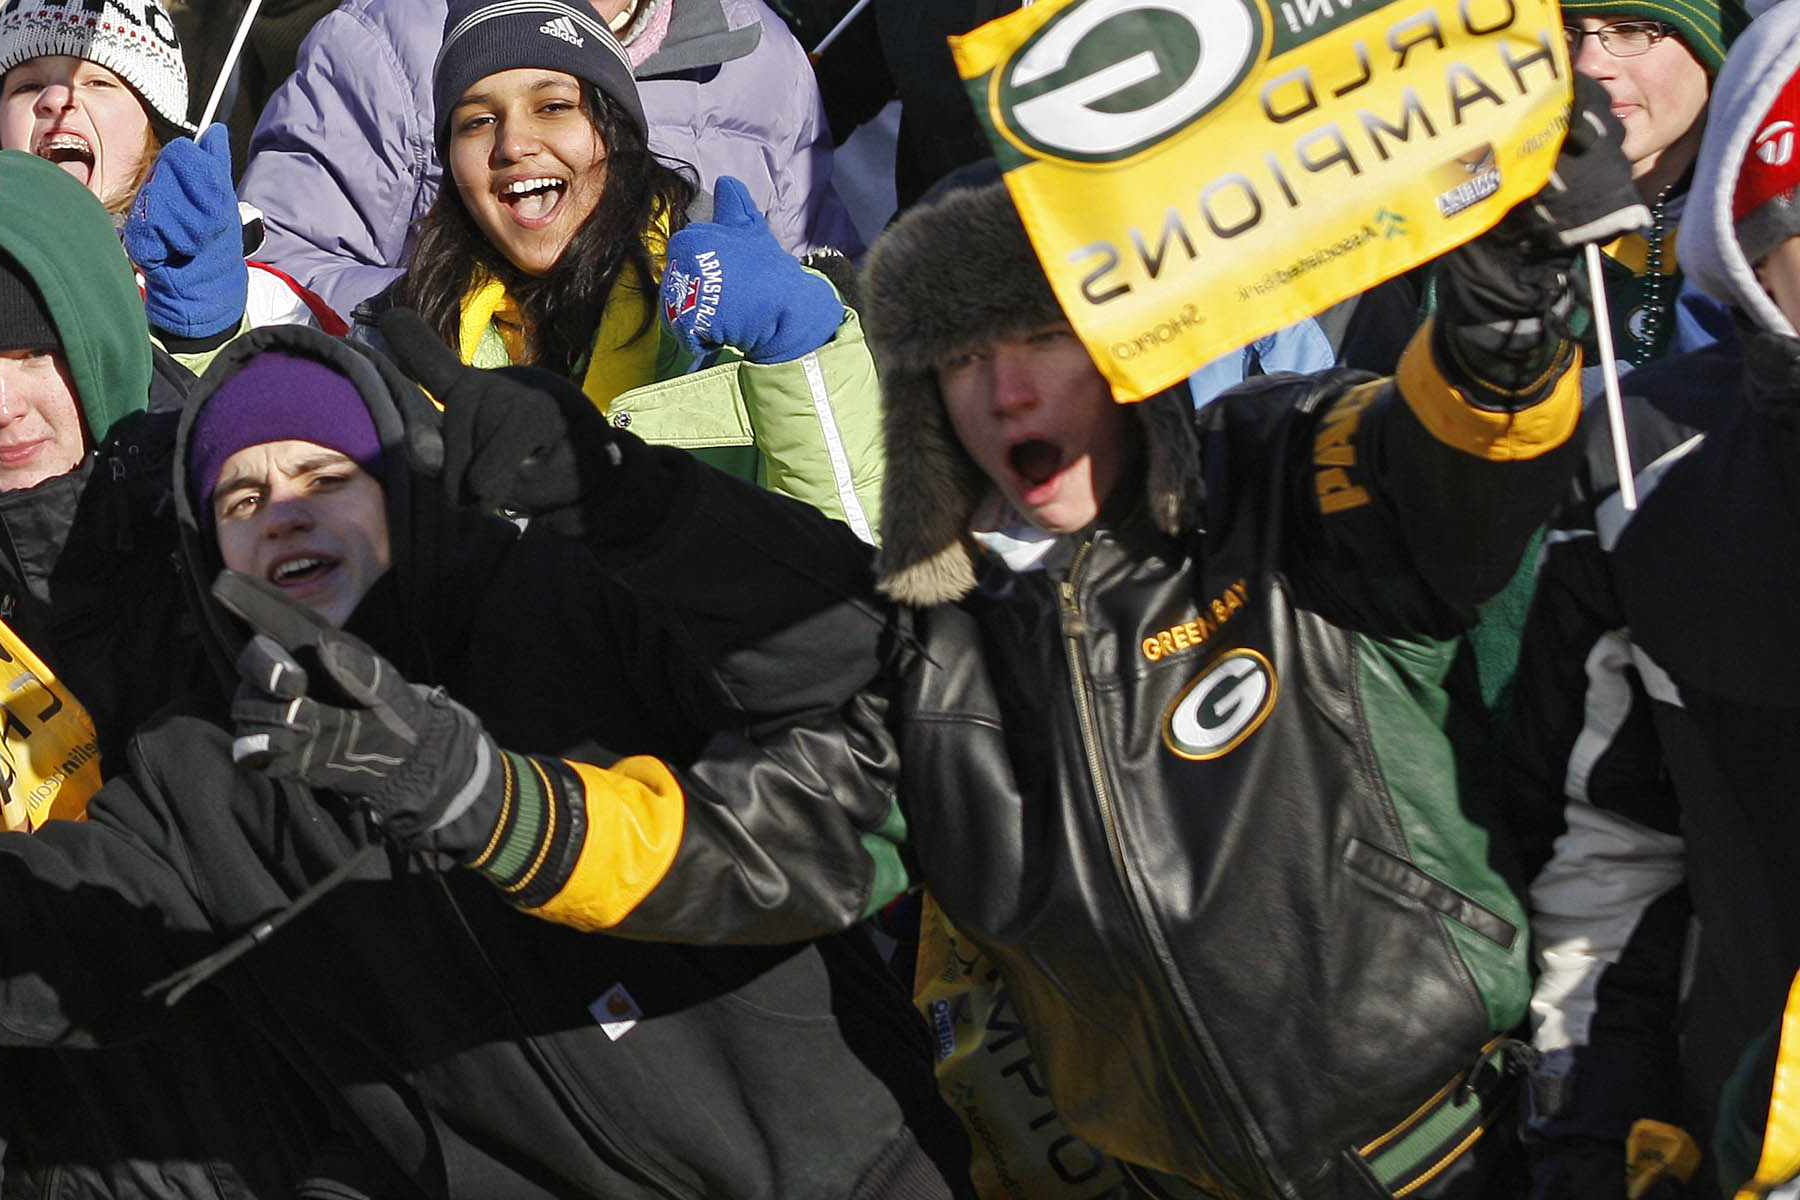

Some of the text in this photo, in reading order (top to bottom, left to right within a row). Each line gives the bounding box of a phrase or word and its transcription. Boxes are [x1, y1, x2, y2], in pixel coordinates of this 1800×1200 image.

[539, 25, 585, 49] adidas
[1142, 577, 1250, 661] GREEN BAY
[1172, 657, 1266, 748] G
